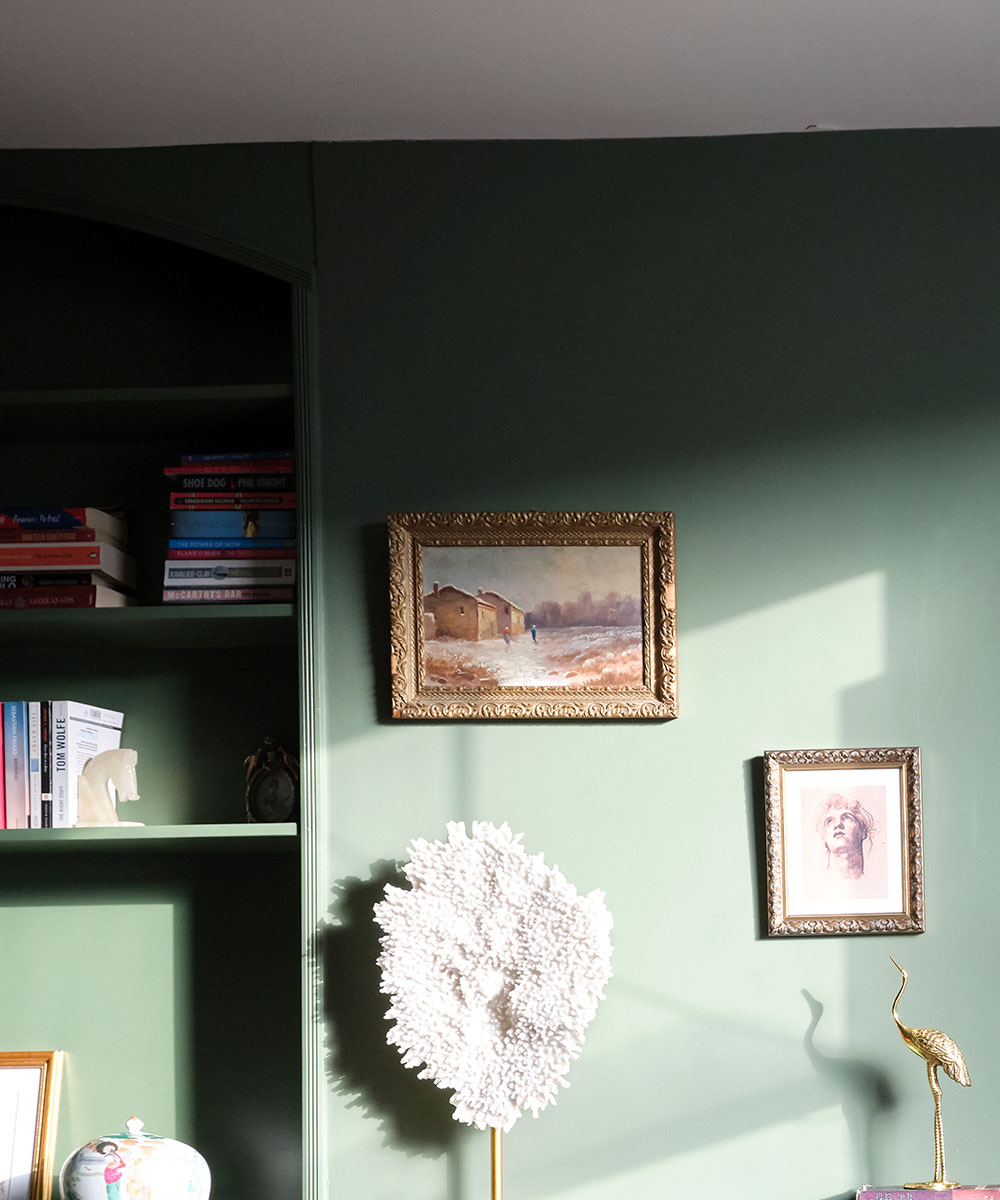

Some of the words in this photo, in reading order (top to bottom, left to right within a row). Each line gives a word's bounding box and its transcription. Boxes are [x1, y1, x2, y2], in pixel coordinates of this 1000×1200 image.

[183, 478, 206, 488] SHOE
[207, 478, 226, 488] DOG
[238, 478, 255, 488] PHIL
[256, 478, 287, 487] KNIGHT
[224, 590, 242, 599] BAR
[56, 718, 66, 750] WOLFE
[56, 752, 66, 772] TOM
